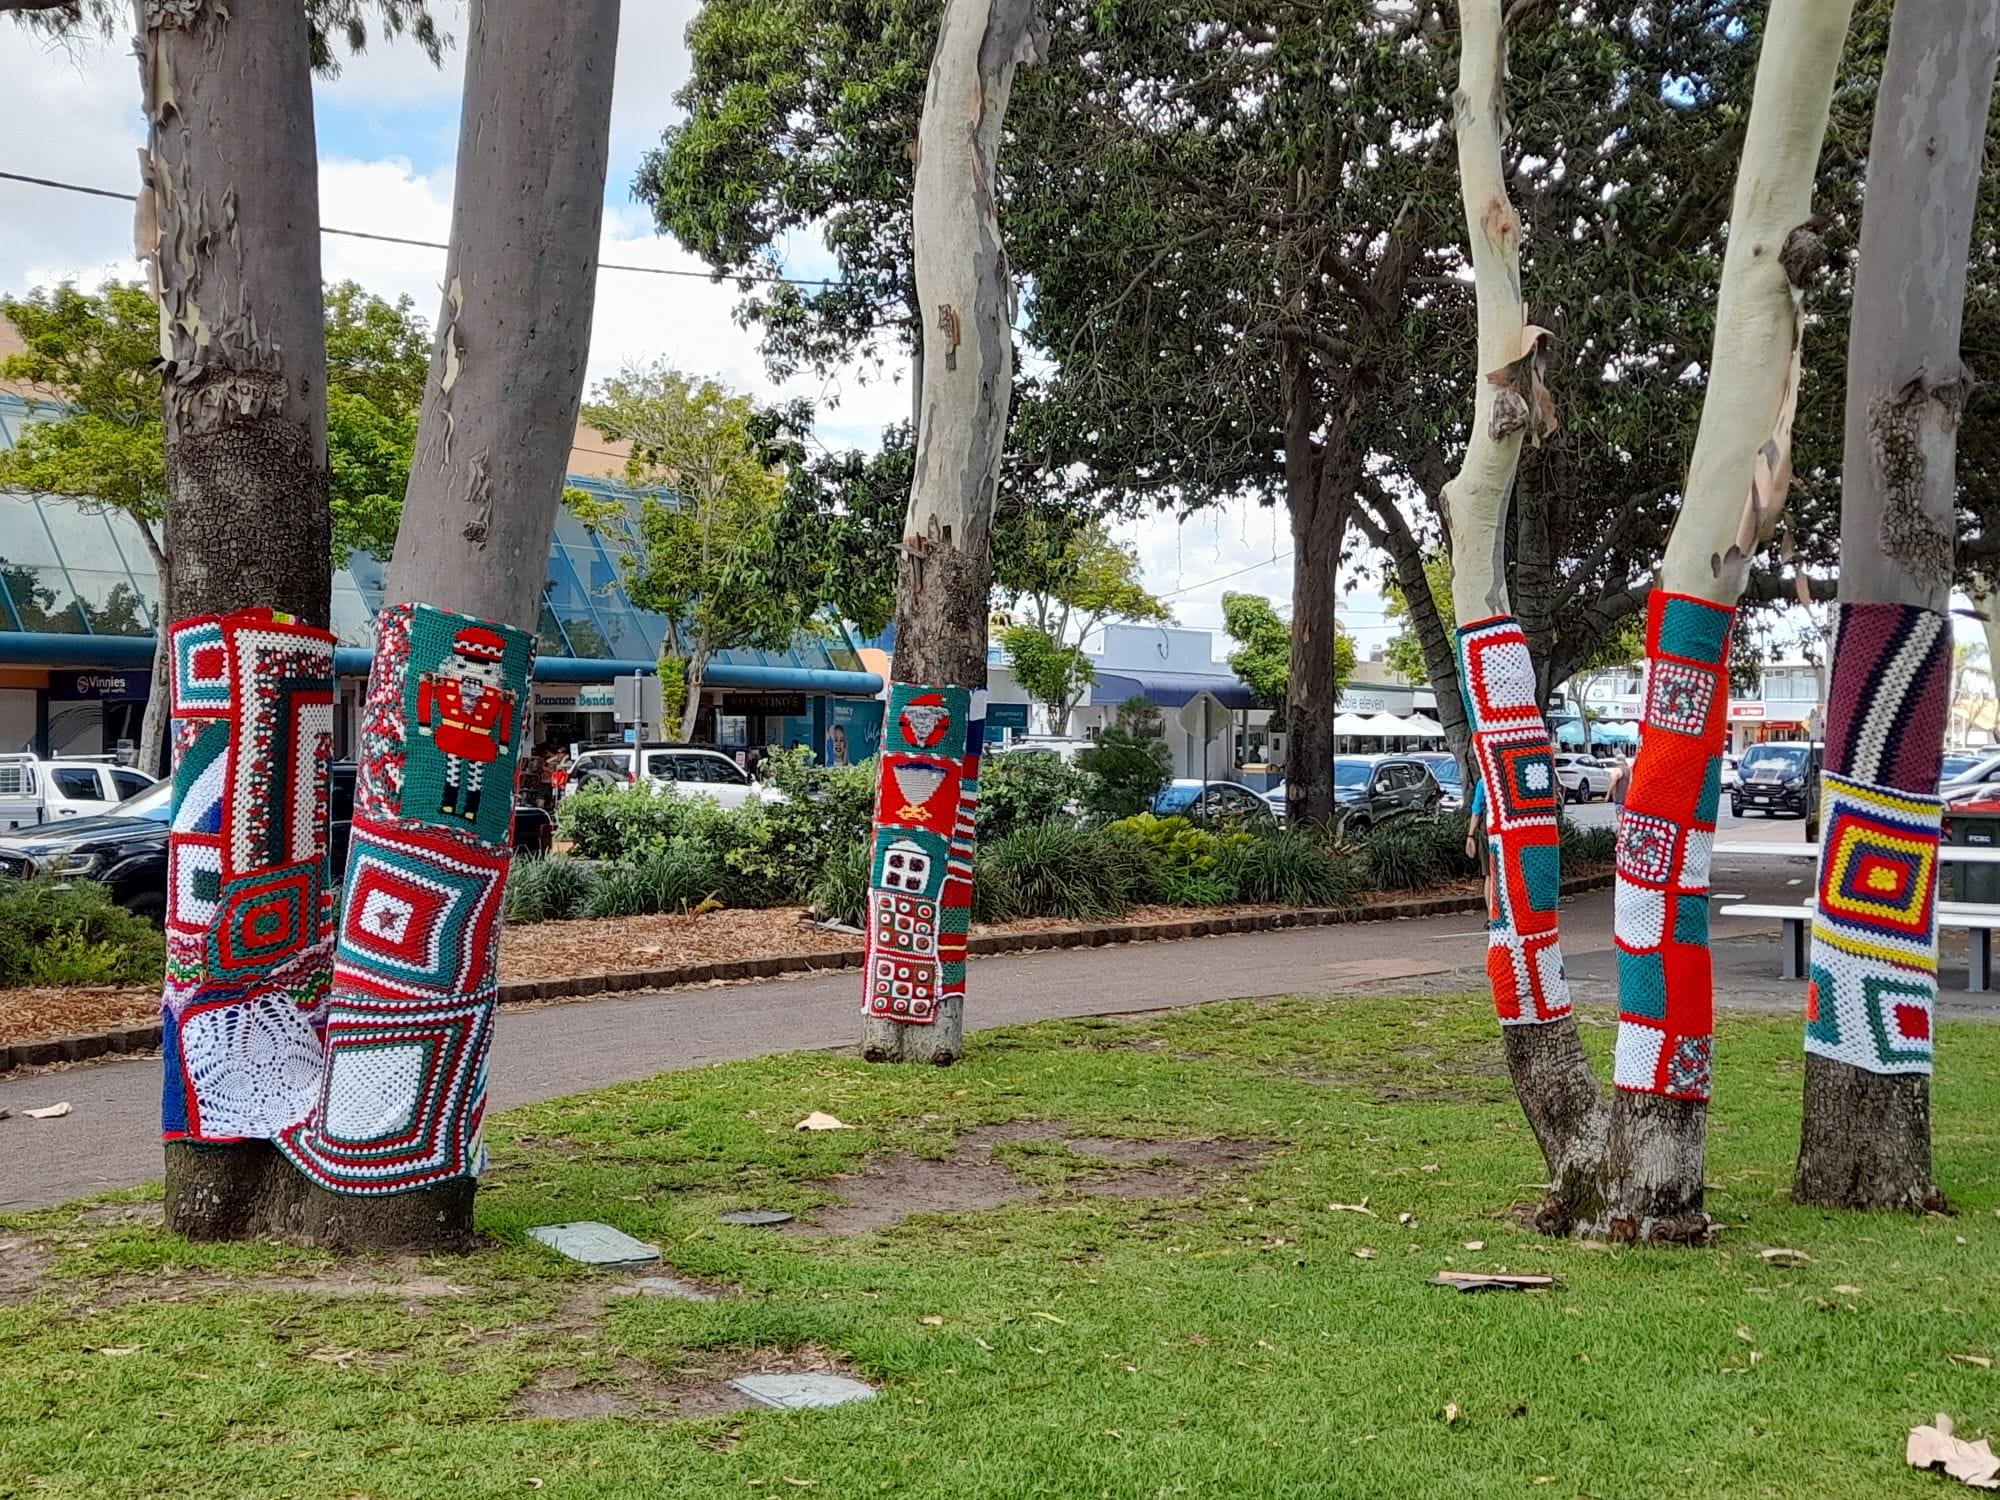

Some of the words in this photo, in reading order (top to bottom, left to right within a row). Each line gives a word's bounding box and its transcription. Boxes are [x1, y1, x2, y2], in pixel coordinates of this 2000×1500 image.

[88, 676, 126, 687] Vinnies
[534, 694, 576, 706] Banana
[731, 696, 799, 708] VALENTINO'S
[1360, 696, 1385, 710] eleven
